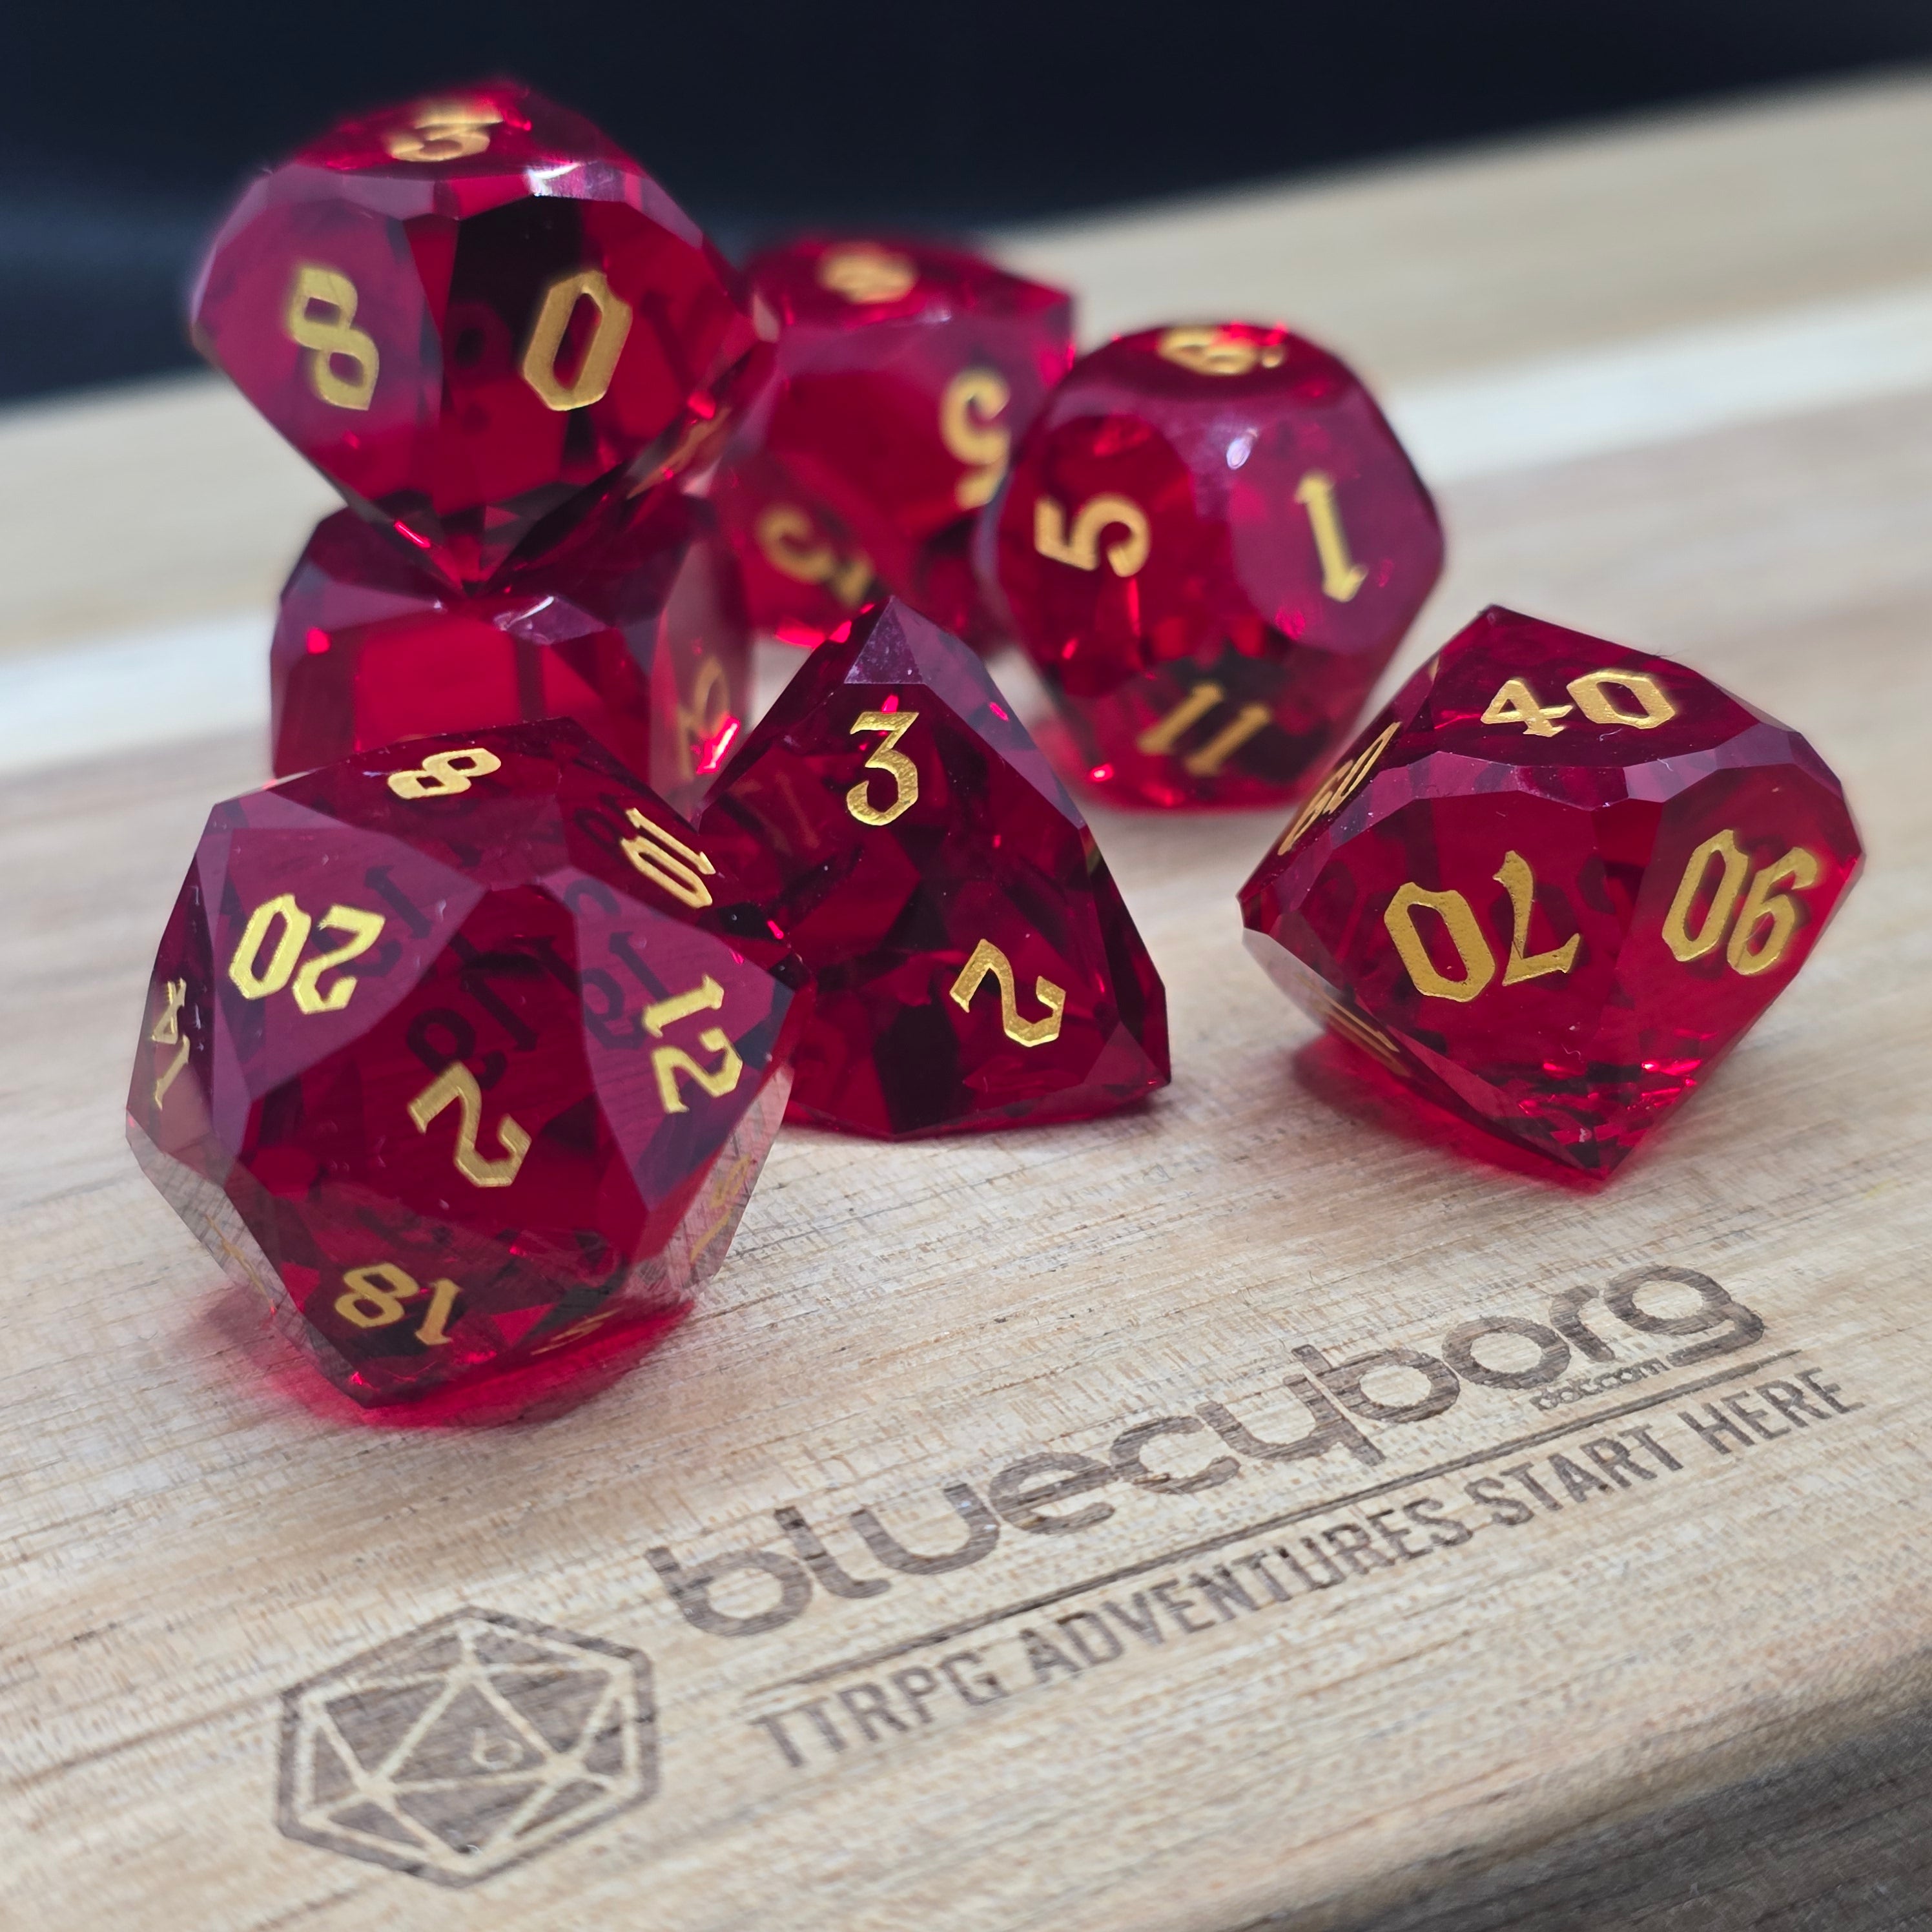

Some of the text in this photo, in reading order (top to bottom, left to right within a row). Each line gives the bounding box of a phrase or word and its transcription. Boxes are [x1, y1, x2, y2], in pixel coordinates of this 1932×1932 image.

[287, 266, 380, 411] 8
[524, 269, 633, 411] 0
[1034, 495, 1151, 578] 5
[1293, 471, 1368, 603] 1
[1136, 681, 1273, 777] 11
[1481, 668, 1676, 737] 40
[387, 748, 502, 799] 8
[847, 712, 920, 826] 3
[620, 807, 715, 909] 10
[1661, 829, 1818, 976] 90
[229, 893, 386, 1014] 20
[1384, 850, 1581, 1003] 70
[642, 972, 743, 1114] 12
[949, 939, 1067, 1048] 2
[407, 1062, 531, 1187] 2
[334, 1262, 464, 1346] 18
[644, 1265, 1766, 1639] bluecyborg
[750, 1366, 1866, 1768] TTRPG ADVENTURES START HERE
